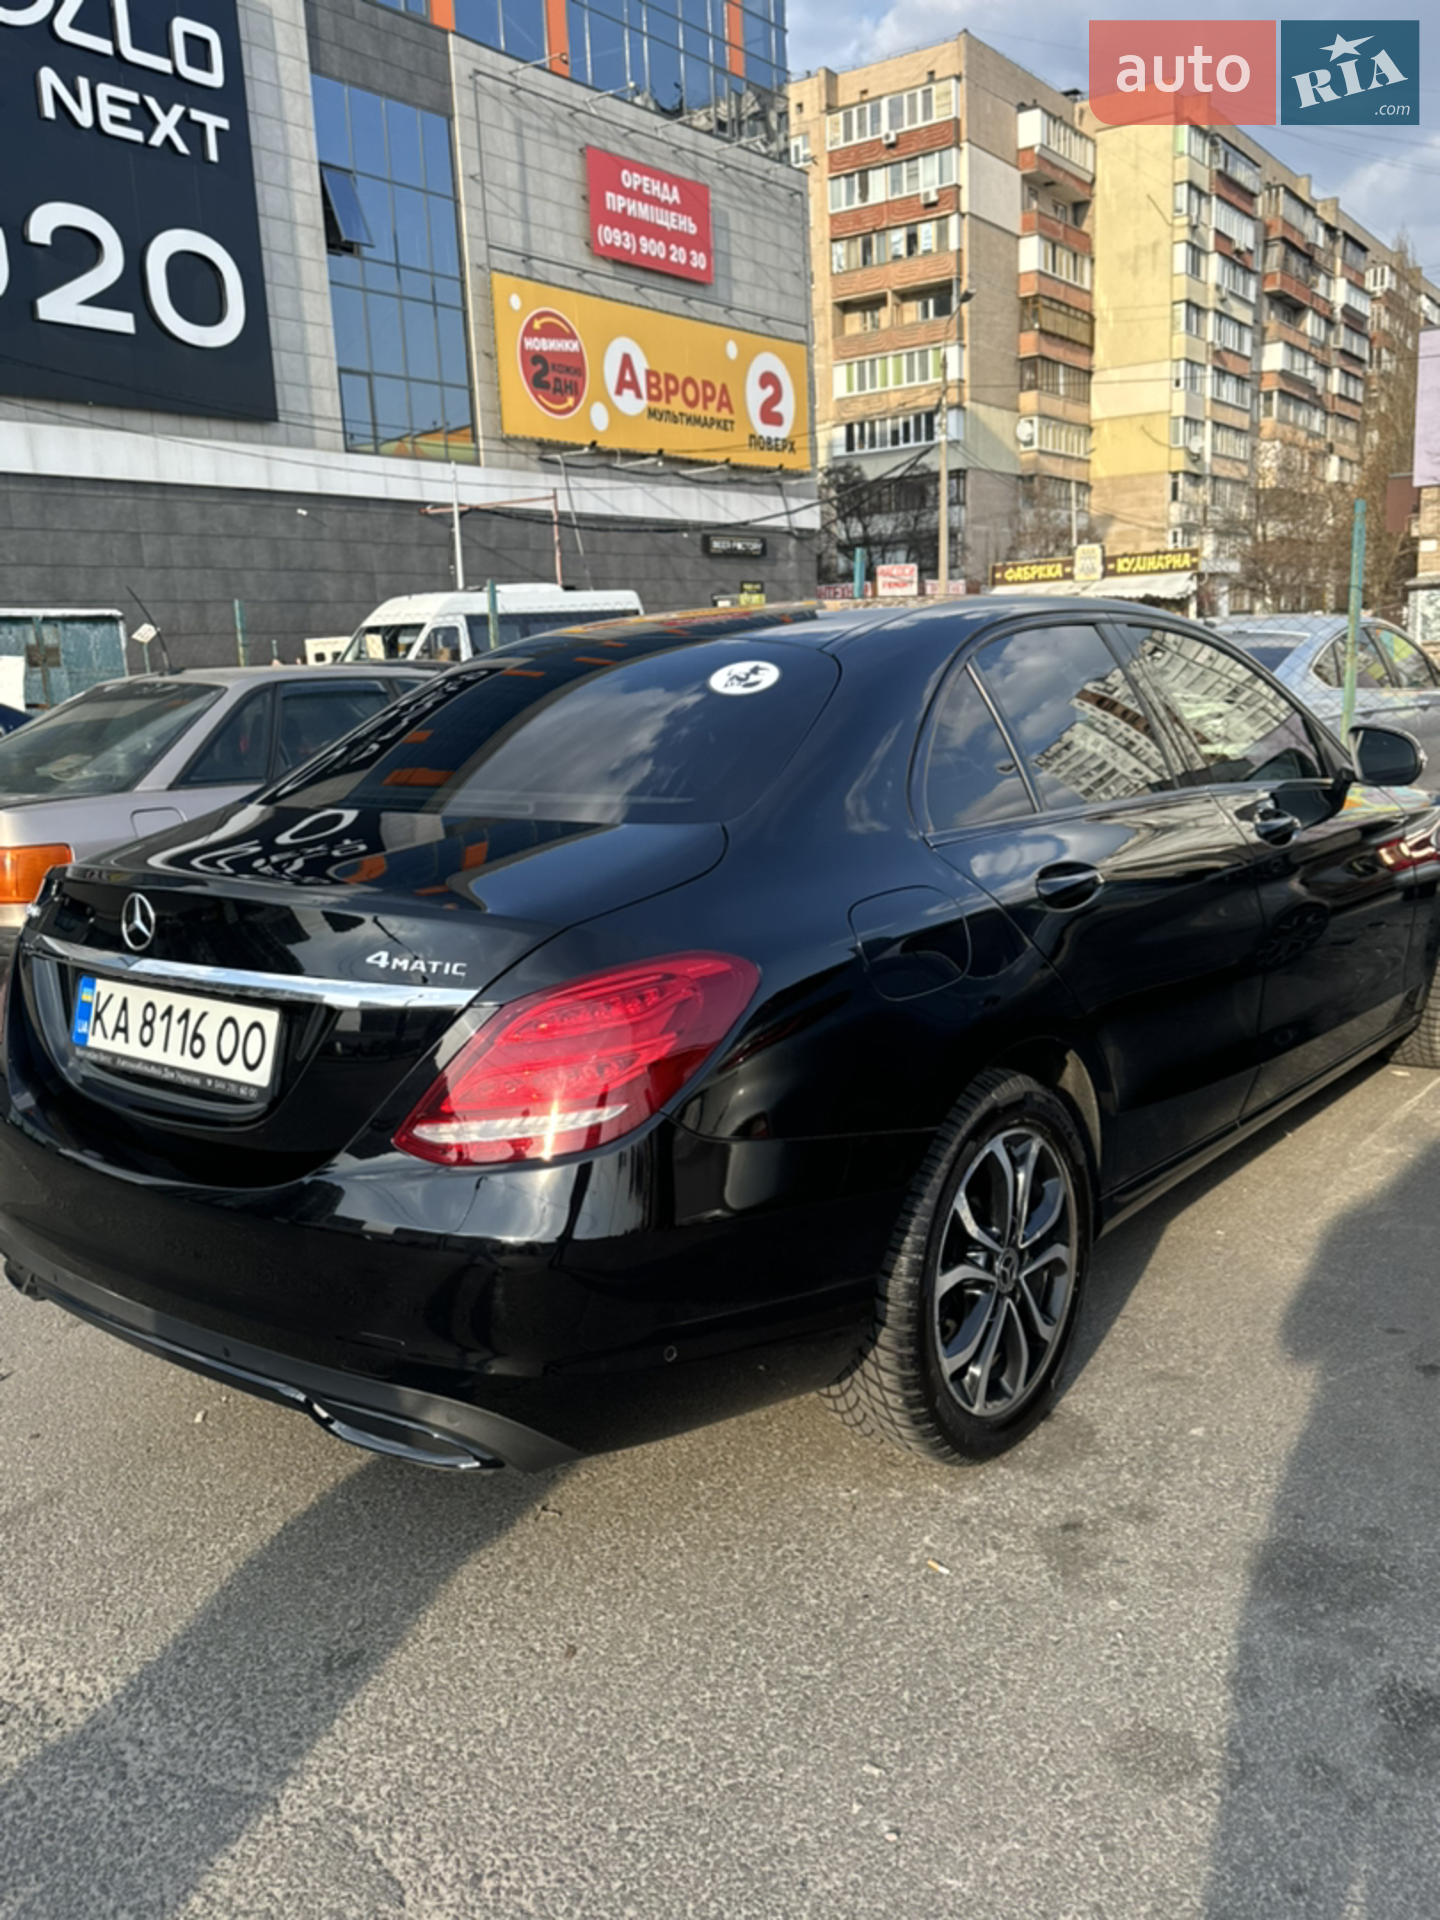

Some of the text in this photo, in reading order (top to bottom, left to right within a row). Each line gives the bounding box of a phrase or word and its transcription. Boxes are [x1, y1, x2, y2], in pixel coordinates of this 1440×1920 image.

[36, 66, 230, 163] NEXT
[621, 168, 681, 205] ОРЕНДА
[605, 190, 697, 235] ПРИМІЩЕНЬ
[597, 223, 707, 270] (093) 900 20 30
[0, 201, 246, 349] 20
[524, 336, 580, 353] НОВИНКИ
[530, 354, 551, 391] 2
[552, 377, 579, 397] ДНІ
[614, 352, 735, 415] АВРОРА
[647, 407, 735, 432] МУЛЬТИМАРКЕТ
[758, 371, 784, 427] 2
[748, 433, 796, 455] ПОВЕРХ
[365, 950, 467, 976] 4MATIC
[91, 991, 129, 1044] KA
[139, 1001, 209, 1060] 8116
